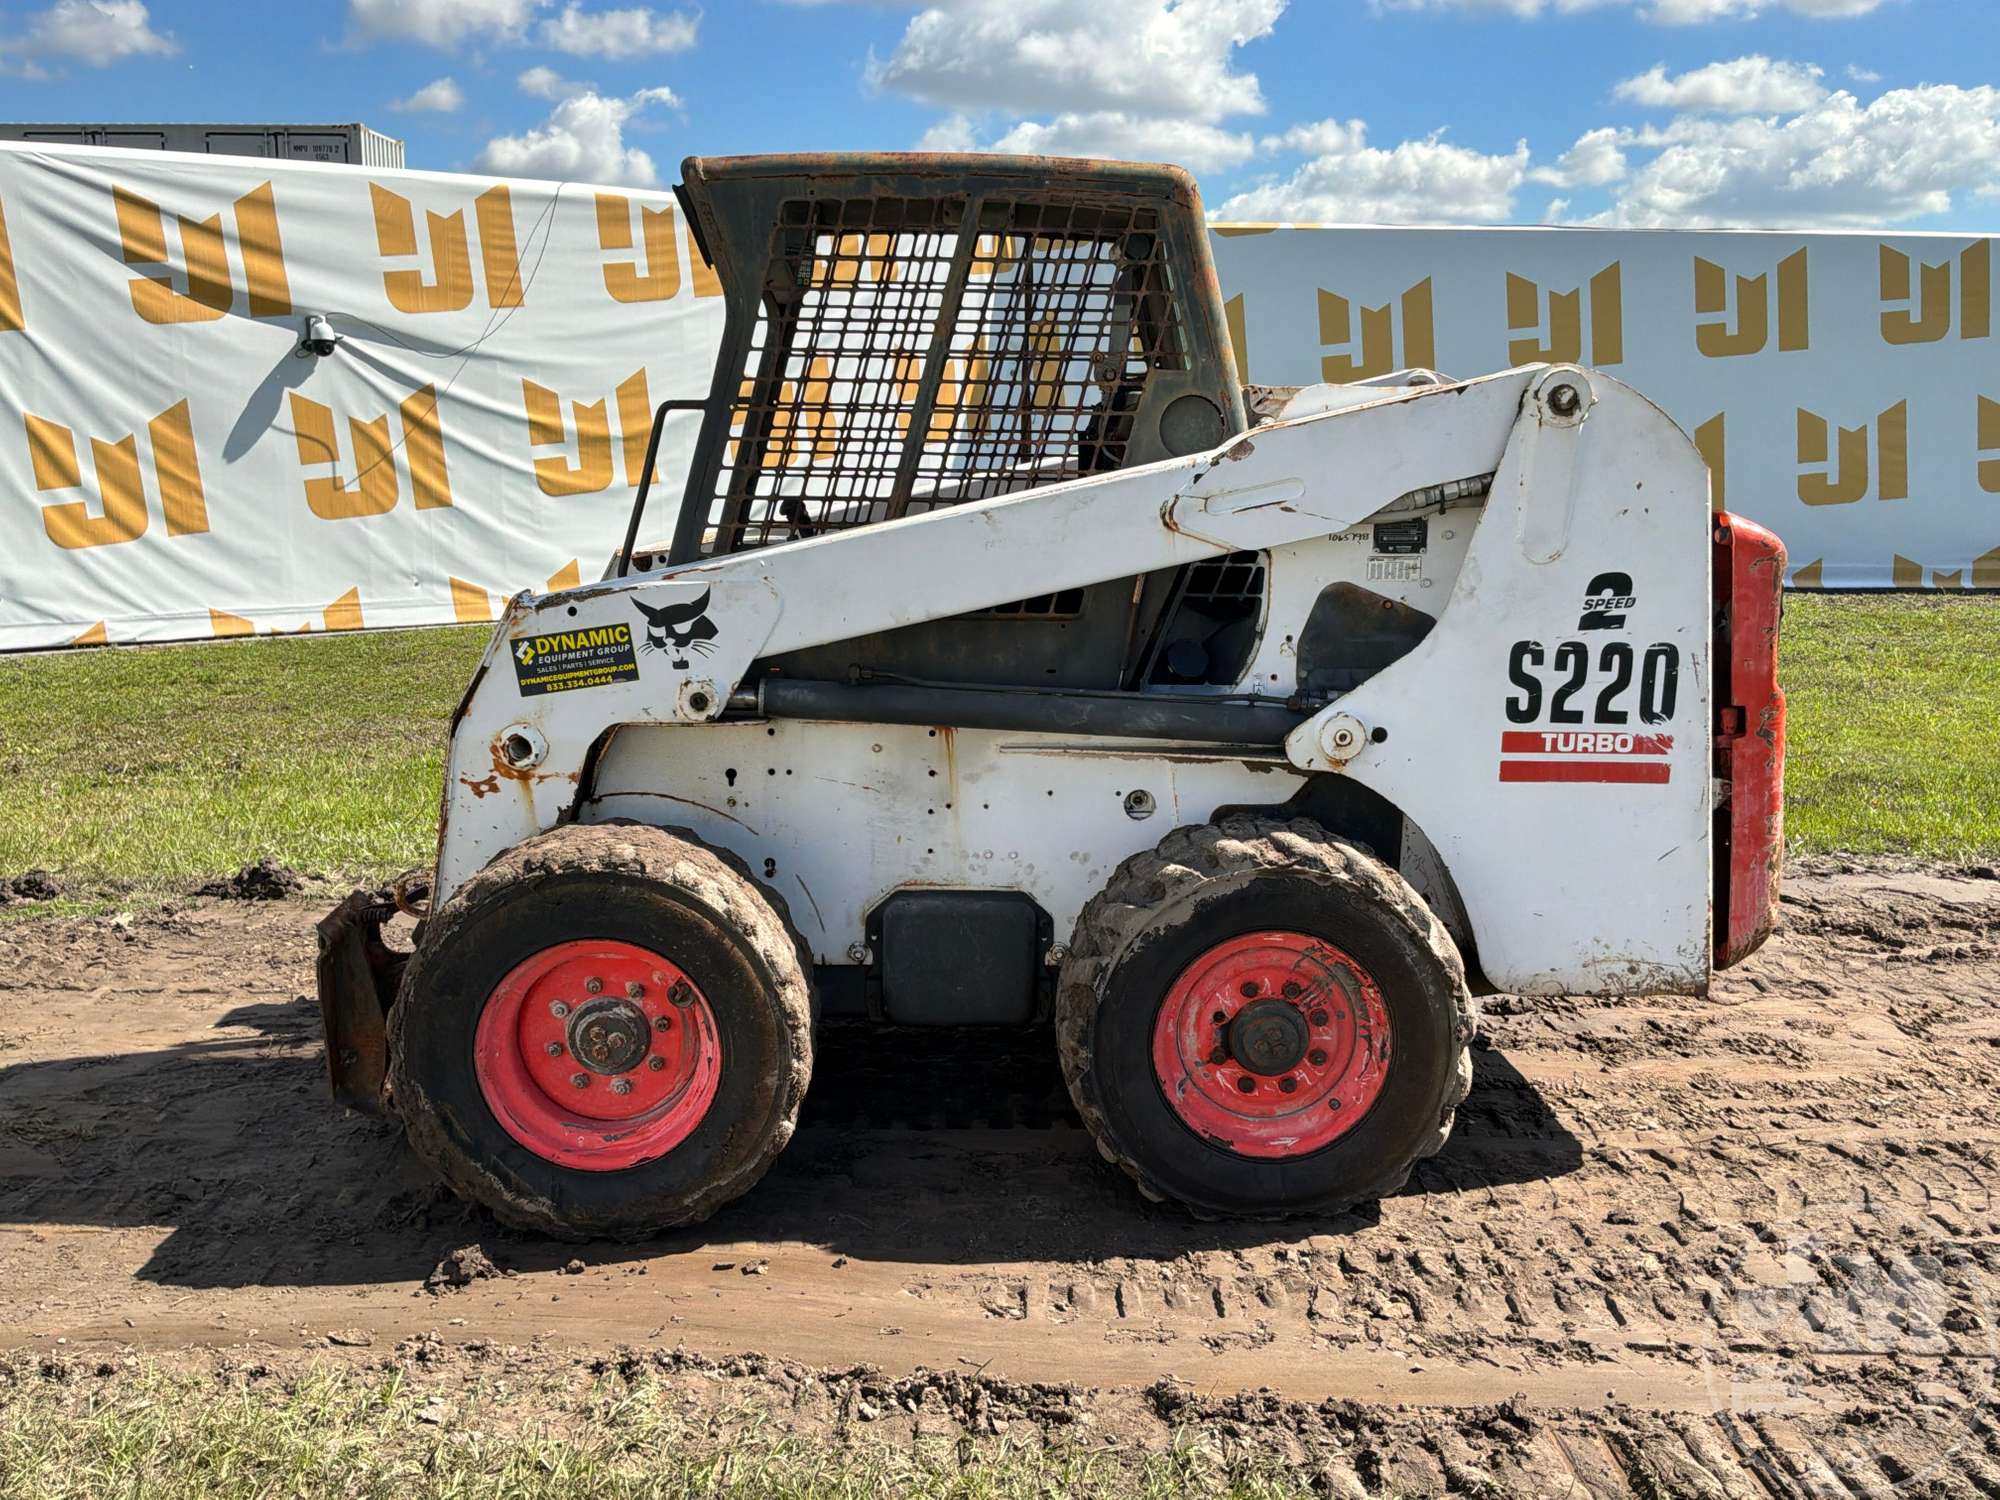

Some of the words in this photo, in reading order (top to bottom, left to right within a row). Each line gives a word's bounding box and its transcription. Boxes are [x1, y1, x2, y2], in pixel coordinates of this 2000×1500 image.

[1577, 571, 1633, 631] 2
[1582, 597, 1637, 611] SPEED
[535, 626, 629, 654] DYNAMIC
[538, 649, 594, 664] EQUIPMENT
[597, 644, 631, 656] GROUP
[520, 663, 636, 686] DYNAMICEQUIPMENTGROUP.COM
[536, 665, 558, 674] SALES
[562, 661, 583, 670] PARTS
[588, 657, 615, 667] SERVICE
[546, 675, 614, 692] 833.334.0444
[1505, 640, 1680, 725] S220
[1541, 733, 1634, 753] TURBO
